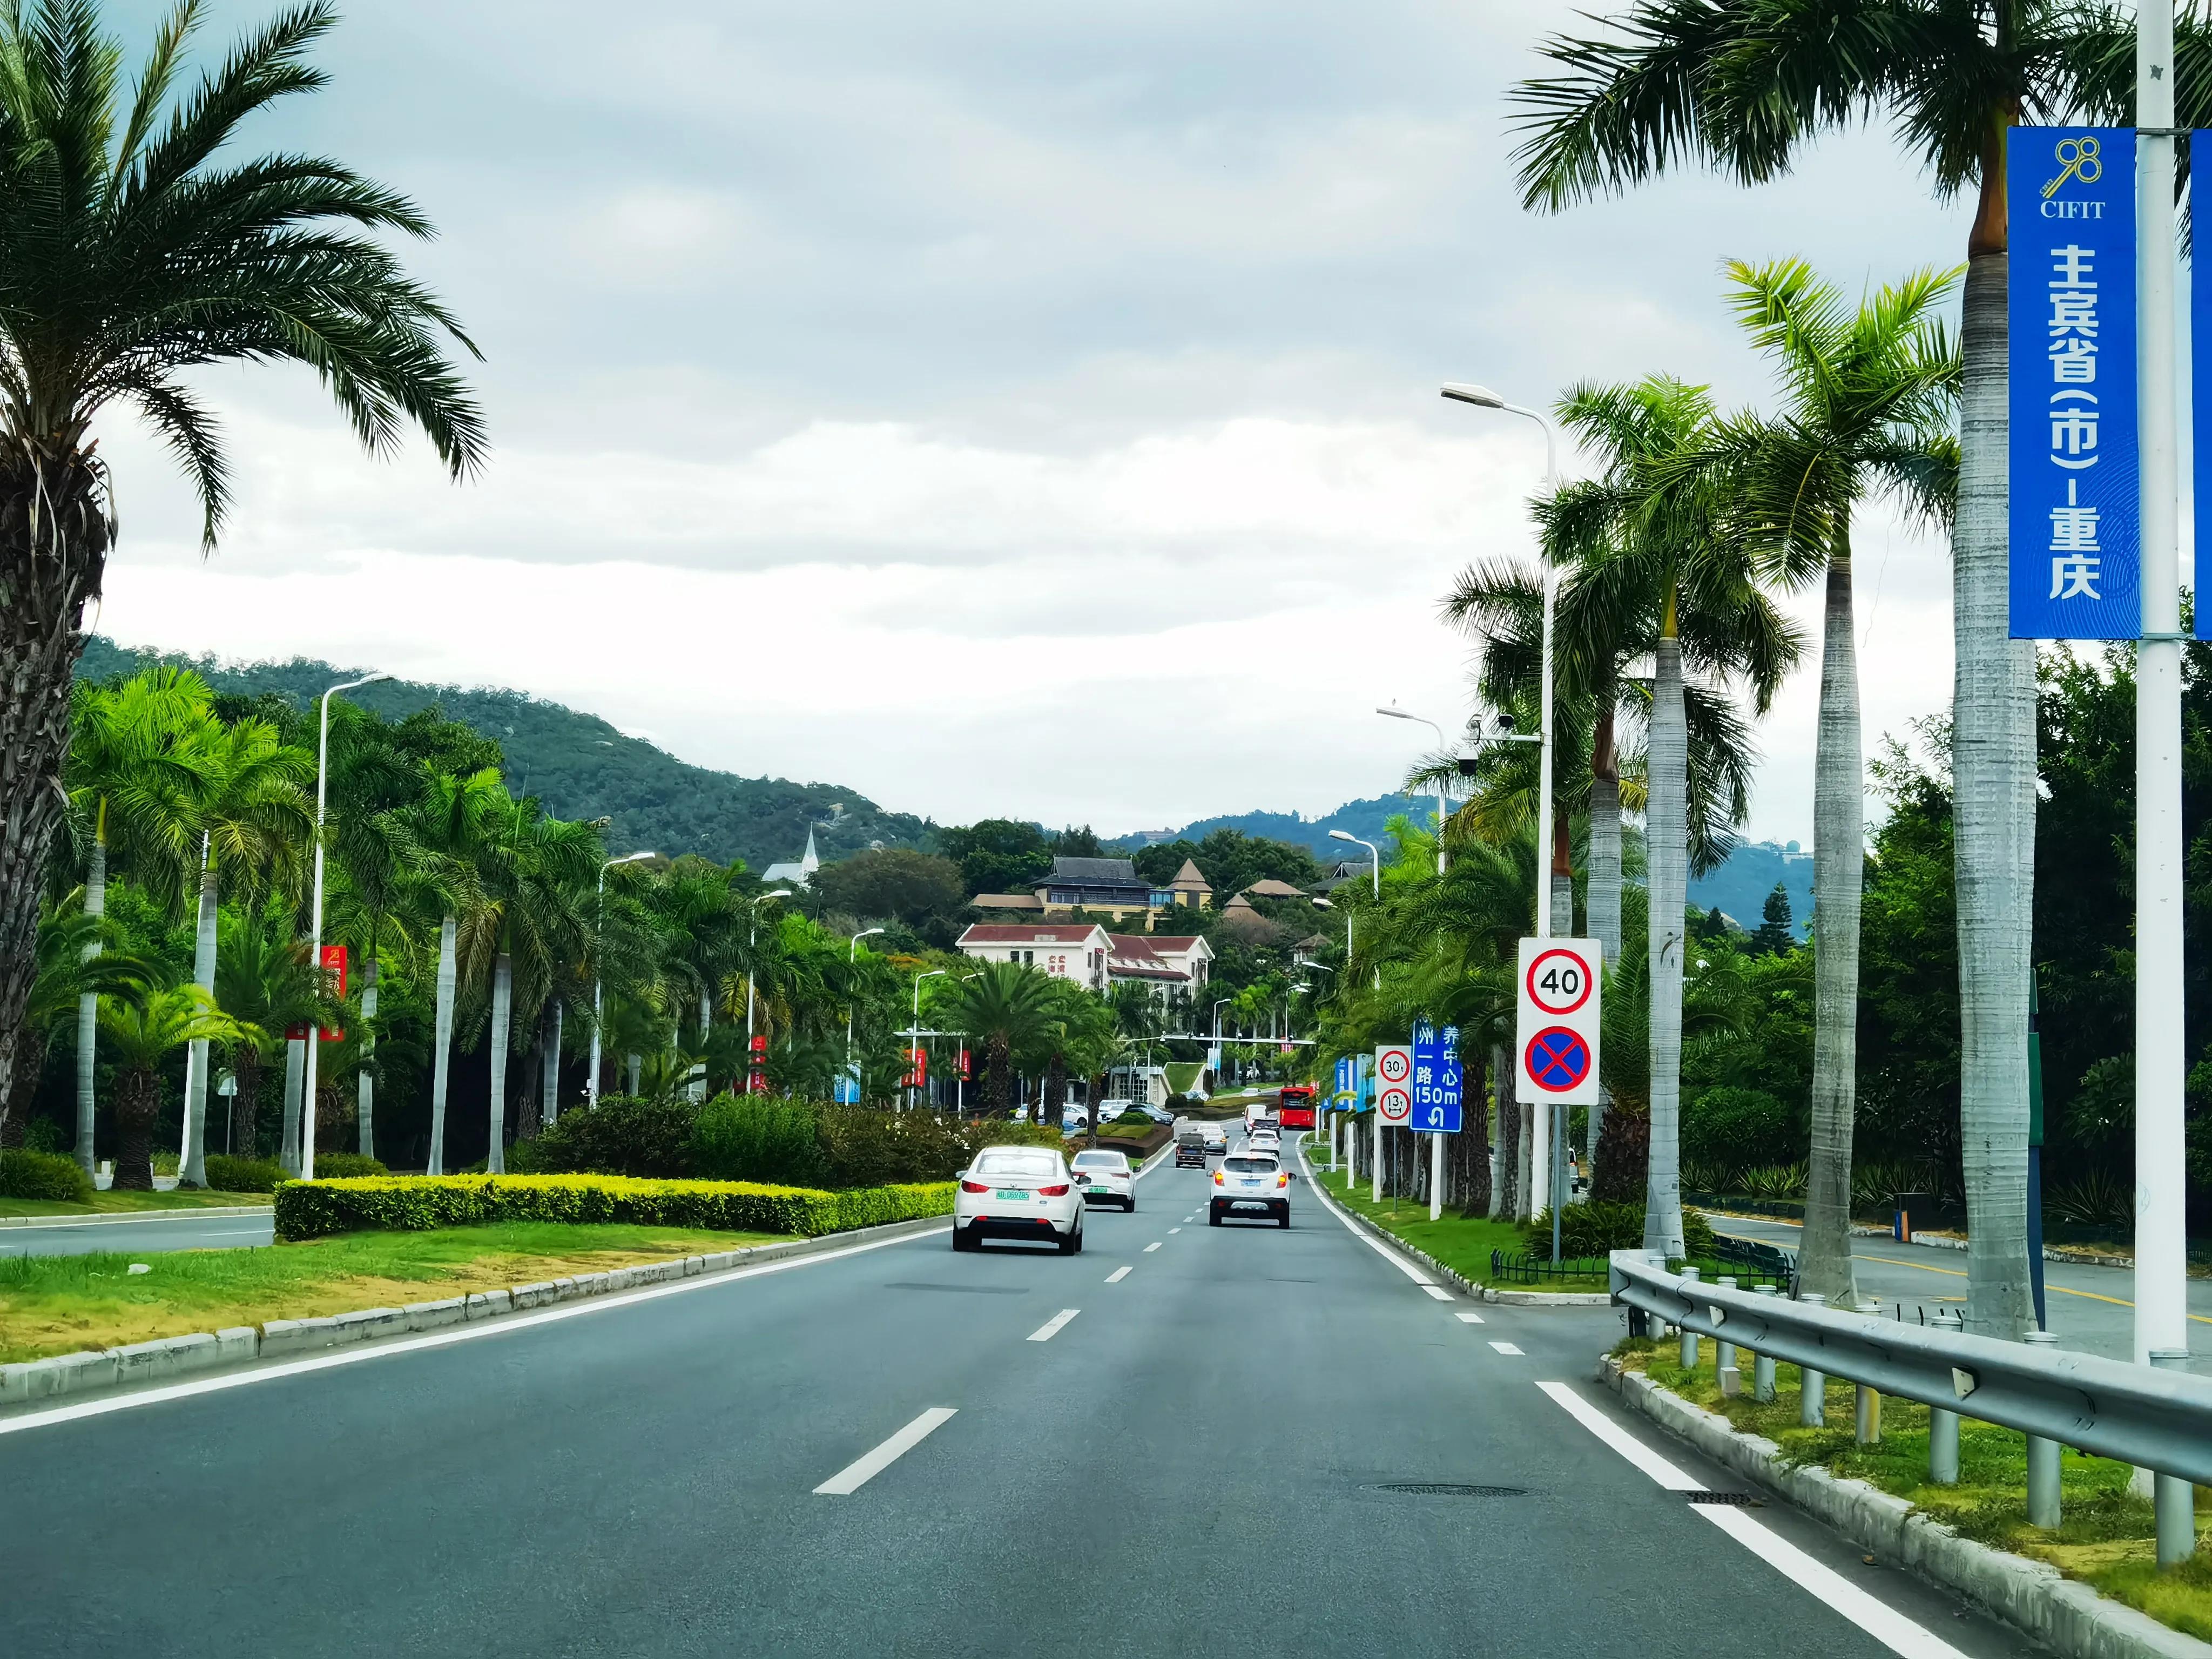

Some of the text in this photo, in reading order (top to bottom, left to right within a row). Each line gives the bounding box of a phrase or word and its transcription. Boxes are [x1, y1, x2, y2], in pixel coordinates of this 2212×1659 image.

[2040, 200, 2106, 219] CIFIT
[1540, 968, 1579, 994] 40
[1415, 1086, 1458, 1105] 150m
